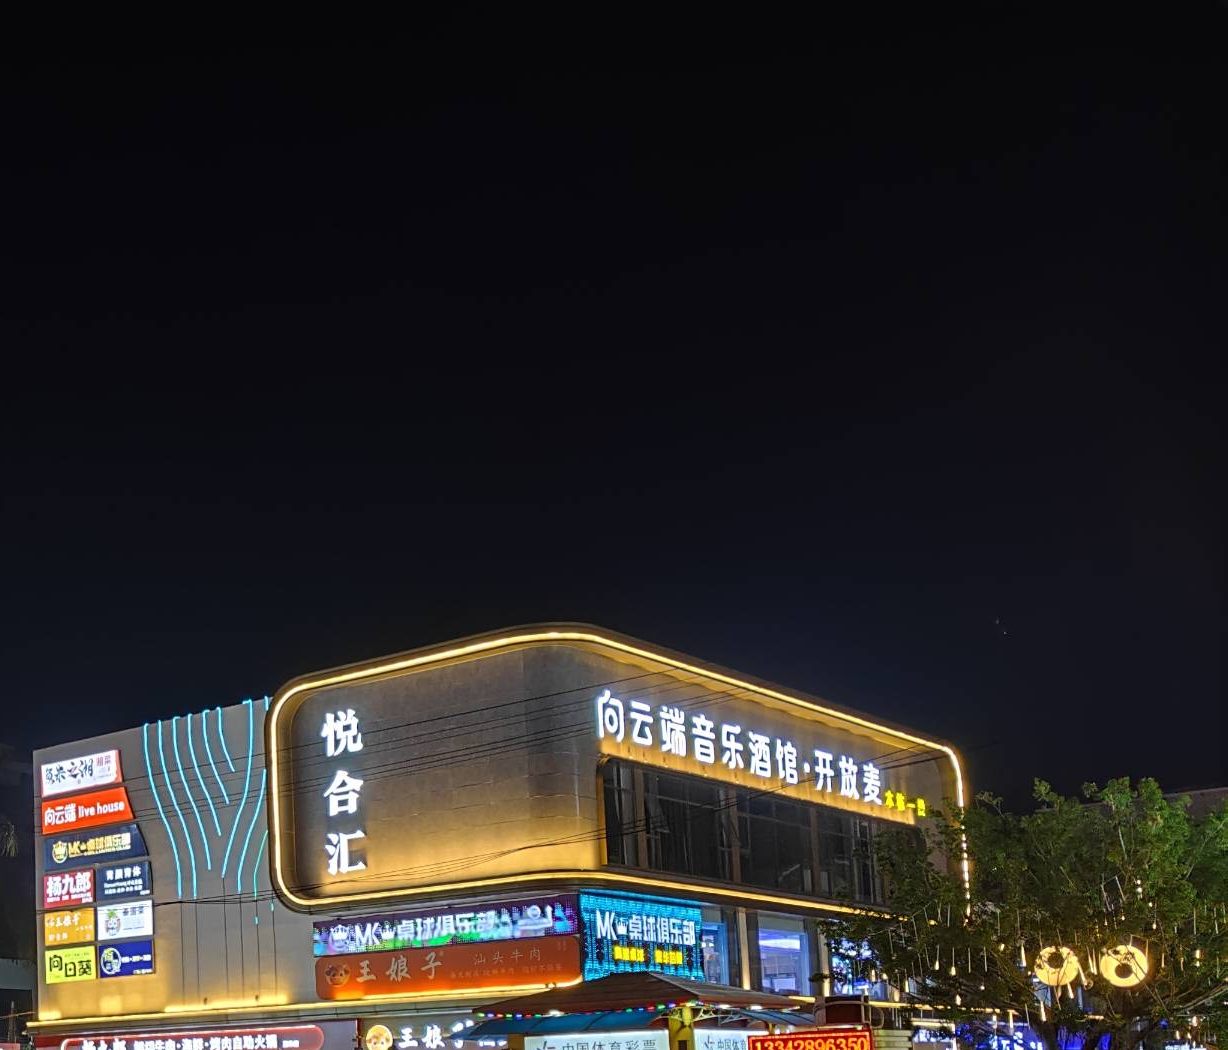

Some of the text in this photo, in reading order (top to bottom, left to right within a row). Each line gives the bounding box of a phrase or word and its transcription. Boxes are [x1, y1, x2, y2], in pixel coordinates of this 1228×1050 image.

[597, 689, 883, 805] 向云端音乐酒馆·开放麦
[321, 708, 368, 876] 悦合汇
[45, 800, 125, 826] 向云端 live house
[46, 871, 92, 897] 杨九郎
[595, 909, 696, 946] MK 桌球俱乐部
[49, 954, 92, 978] 向日葵
[355, 951, 443, 983] 王娘子
[473, 948, 542, 966] 汕头牛肉
